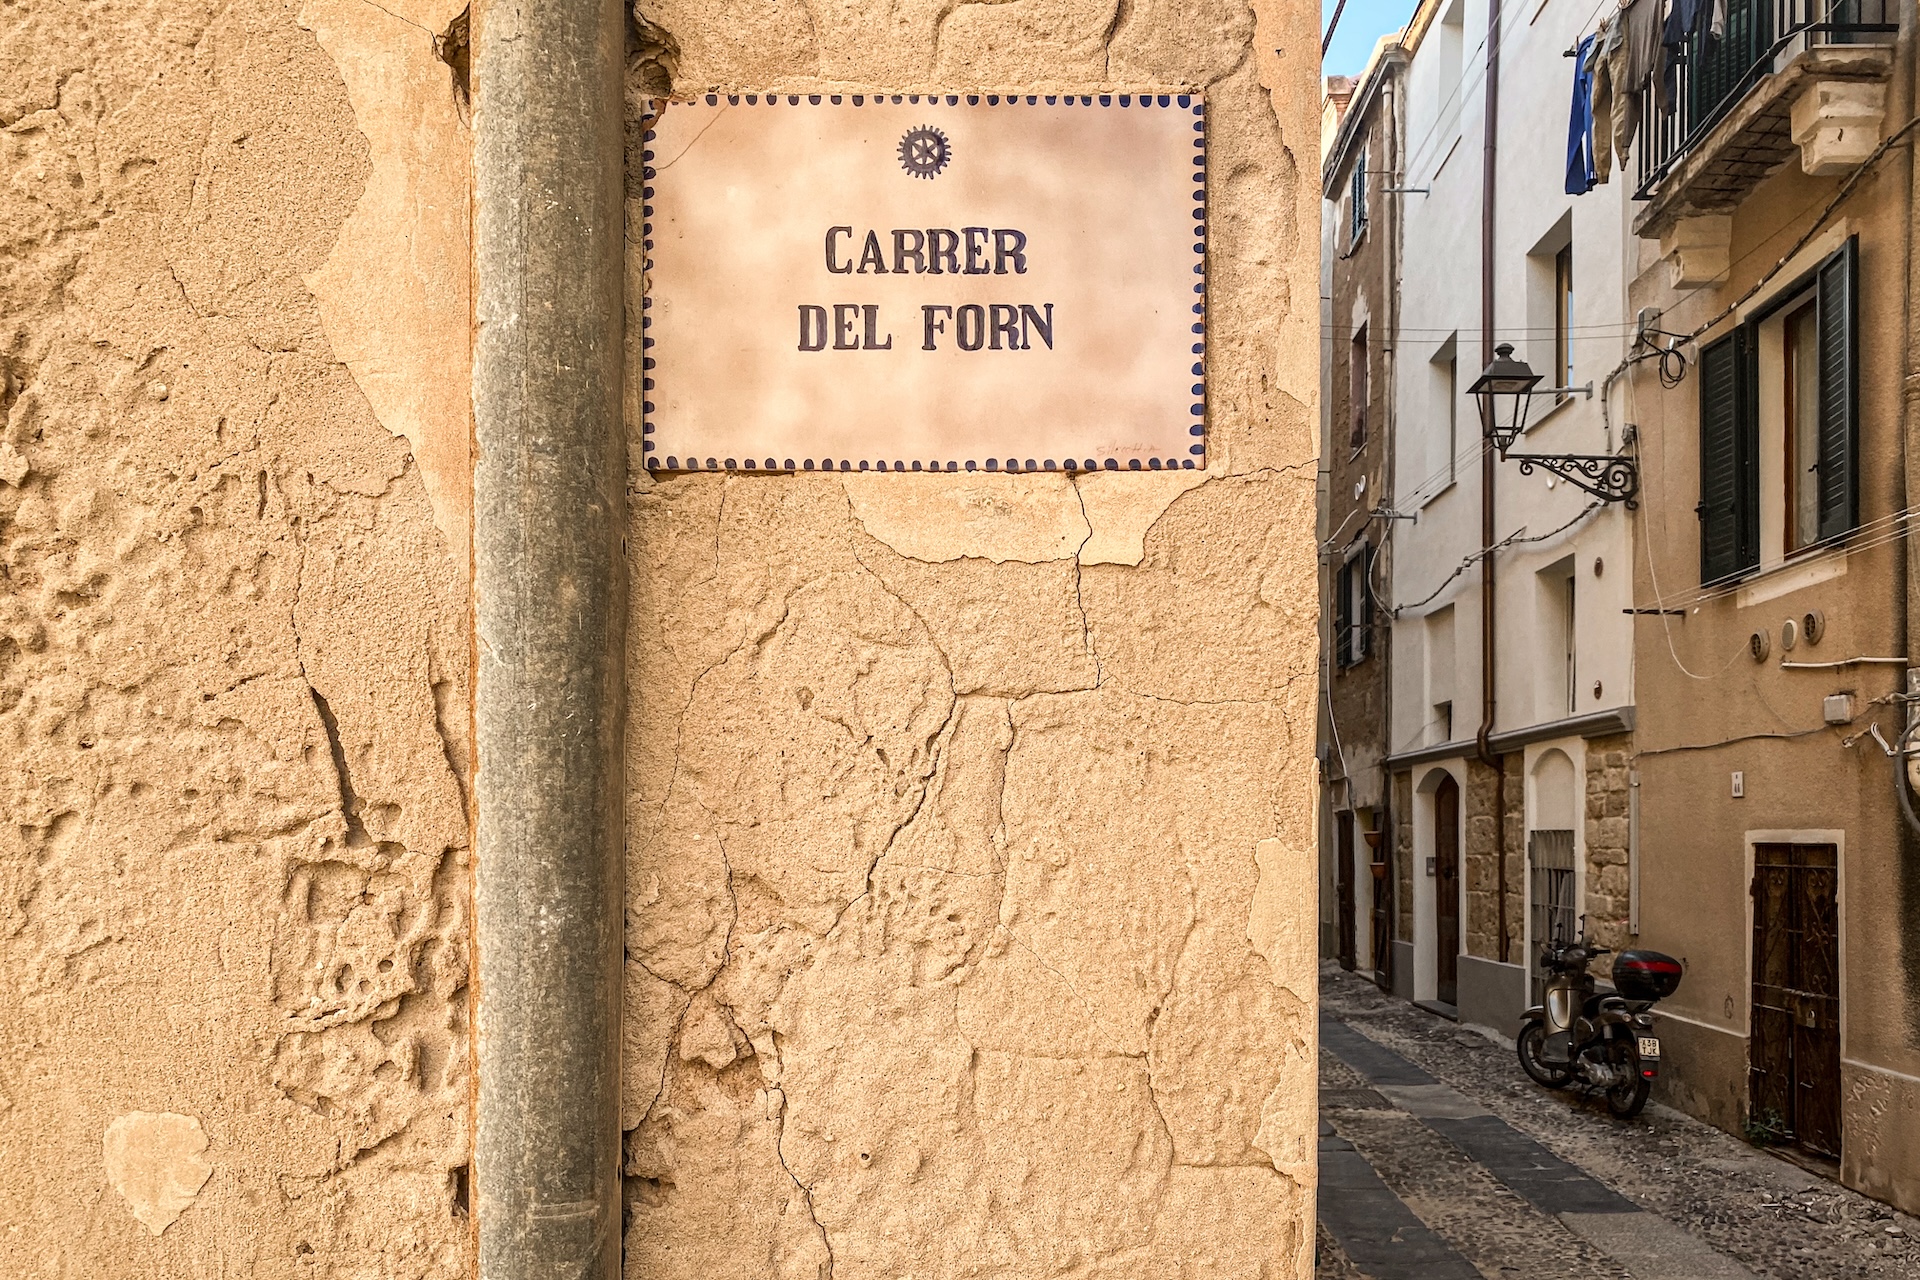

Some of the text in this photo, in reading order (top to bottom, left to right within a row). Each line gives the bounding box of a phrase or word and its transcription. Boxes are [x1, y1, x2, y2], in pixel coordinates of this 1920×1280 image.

[825, 226, 1028, 275] CARRER
[797, 303, 1055, 352] DEL FORN
